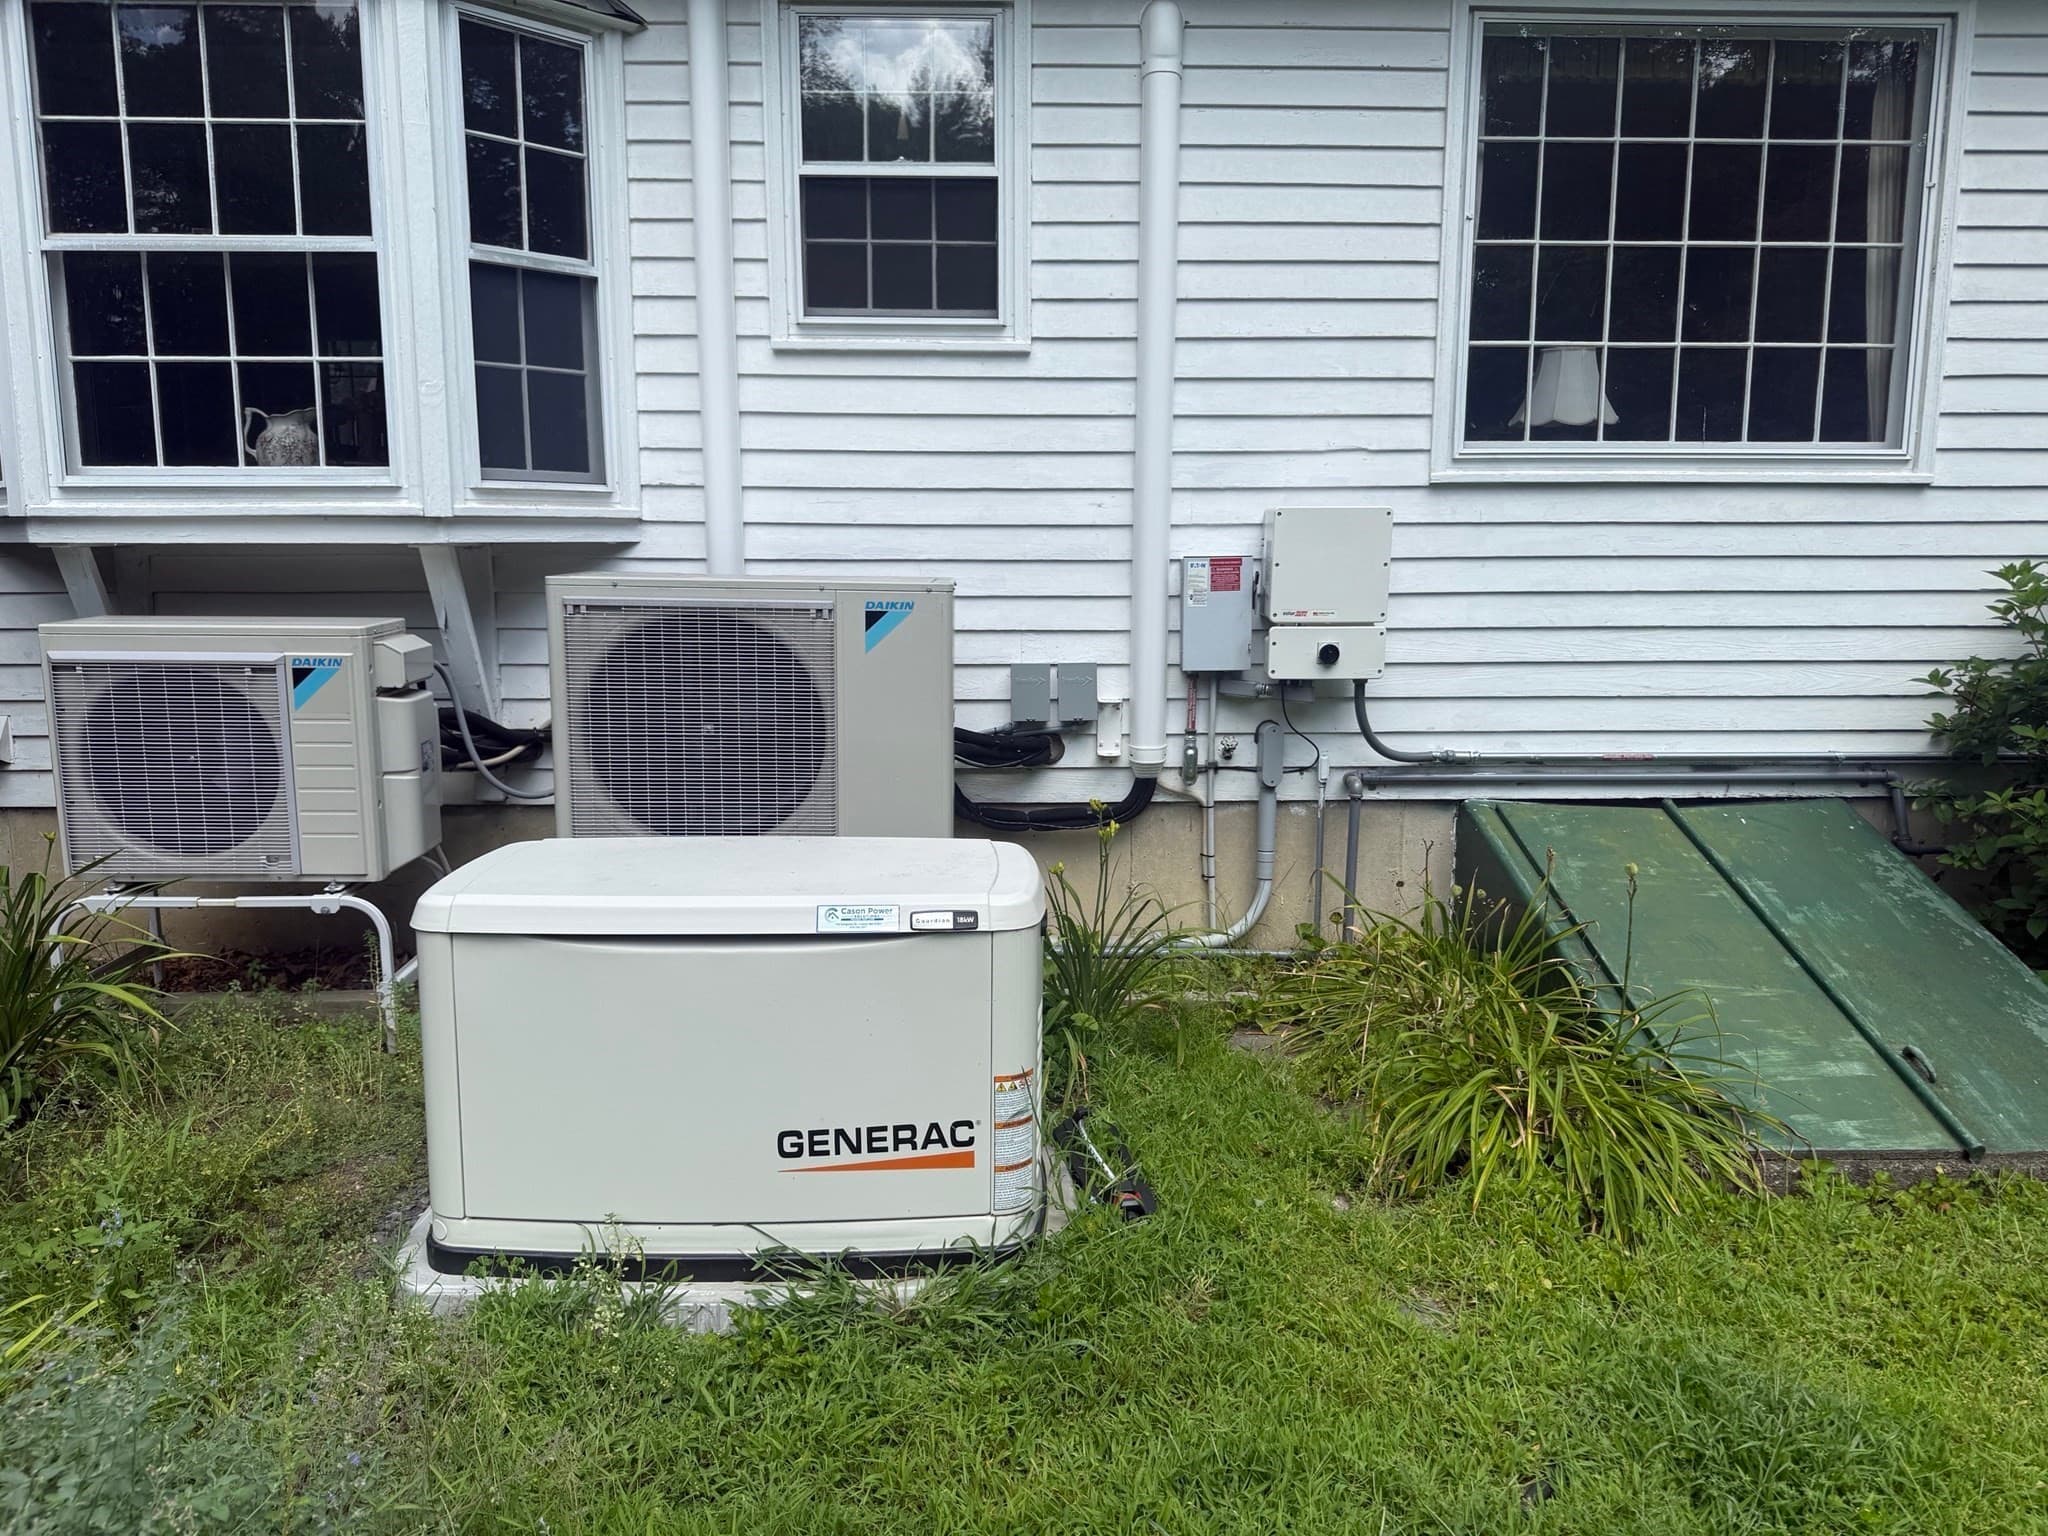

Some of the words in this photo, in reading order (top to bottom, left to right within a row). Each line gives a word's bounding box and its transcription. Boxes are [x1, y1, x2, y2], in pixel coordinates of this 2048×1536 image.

[865, 601, 914, 610] DAIKIN
[292, 657, 343, 666] DAIKIN
[777, 1120, 975, 1159] GENERAC
